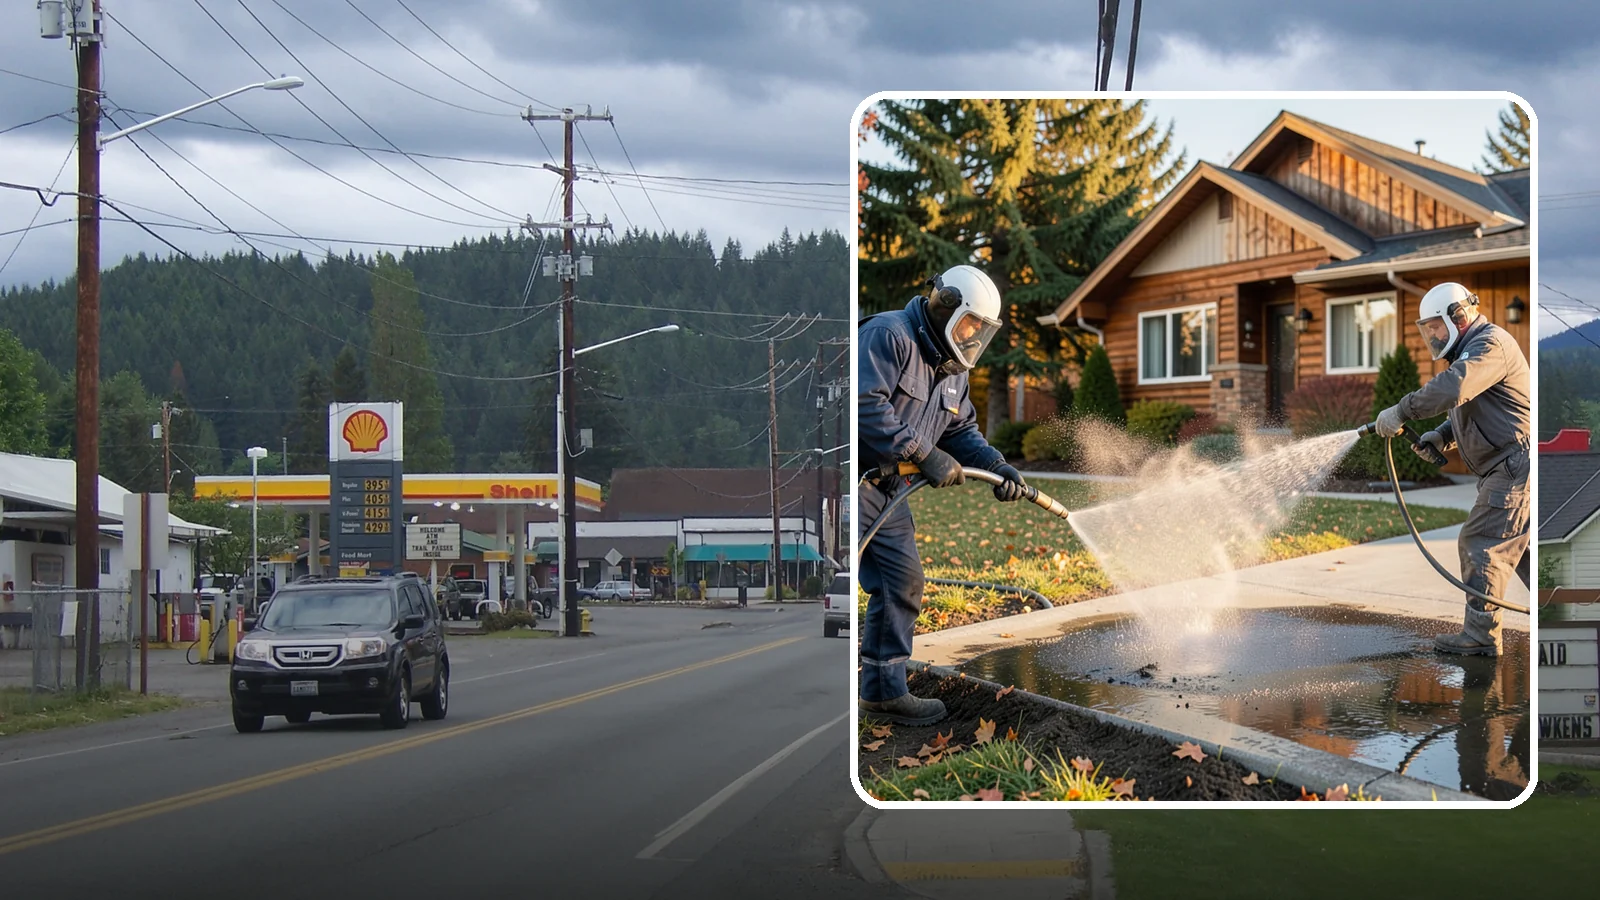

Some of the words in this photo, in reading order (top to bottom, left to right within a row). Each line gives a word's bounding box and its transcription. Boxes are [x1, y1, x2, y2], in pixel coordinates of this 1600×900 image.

[366, 480, 383, 490] 395
[490, 484, 547, 499] Shell
[366, 494, 383, 504] 405
[366, 508, 383, 518] 415
[366, 523, 383, 533] 429
